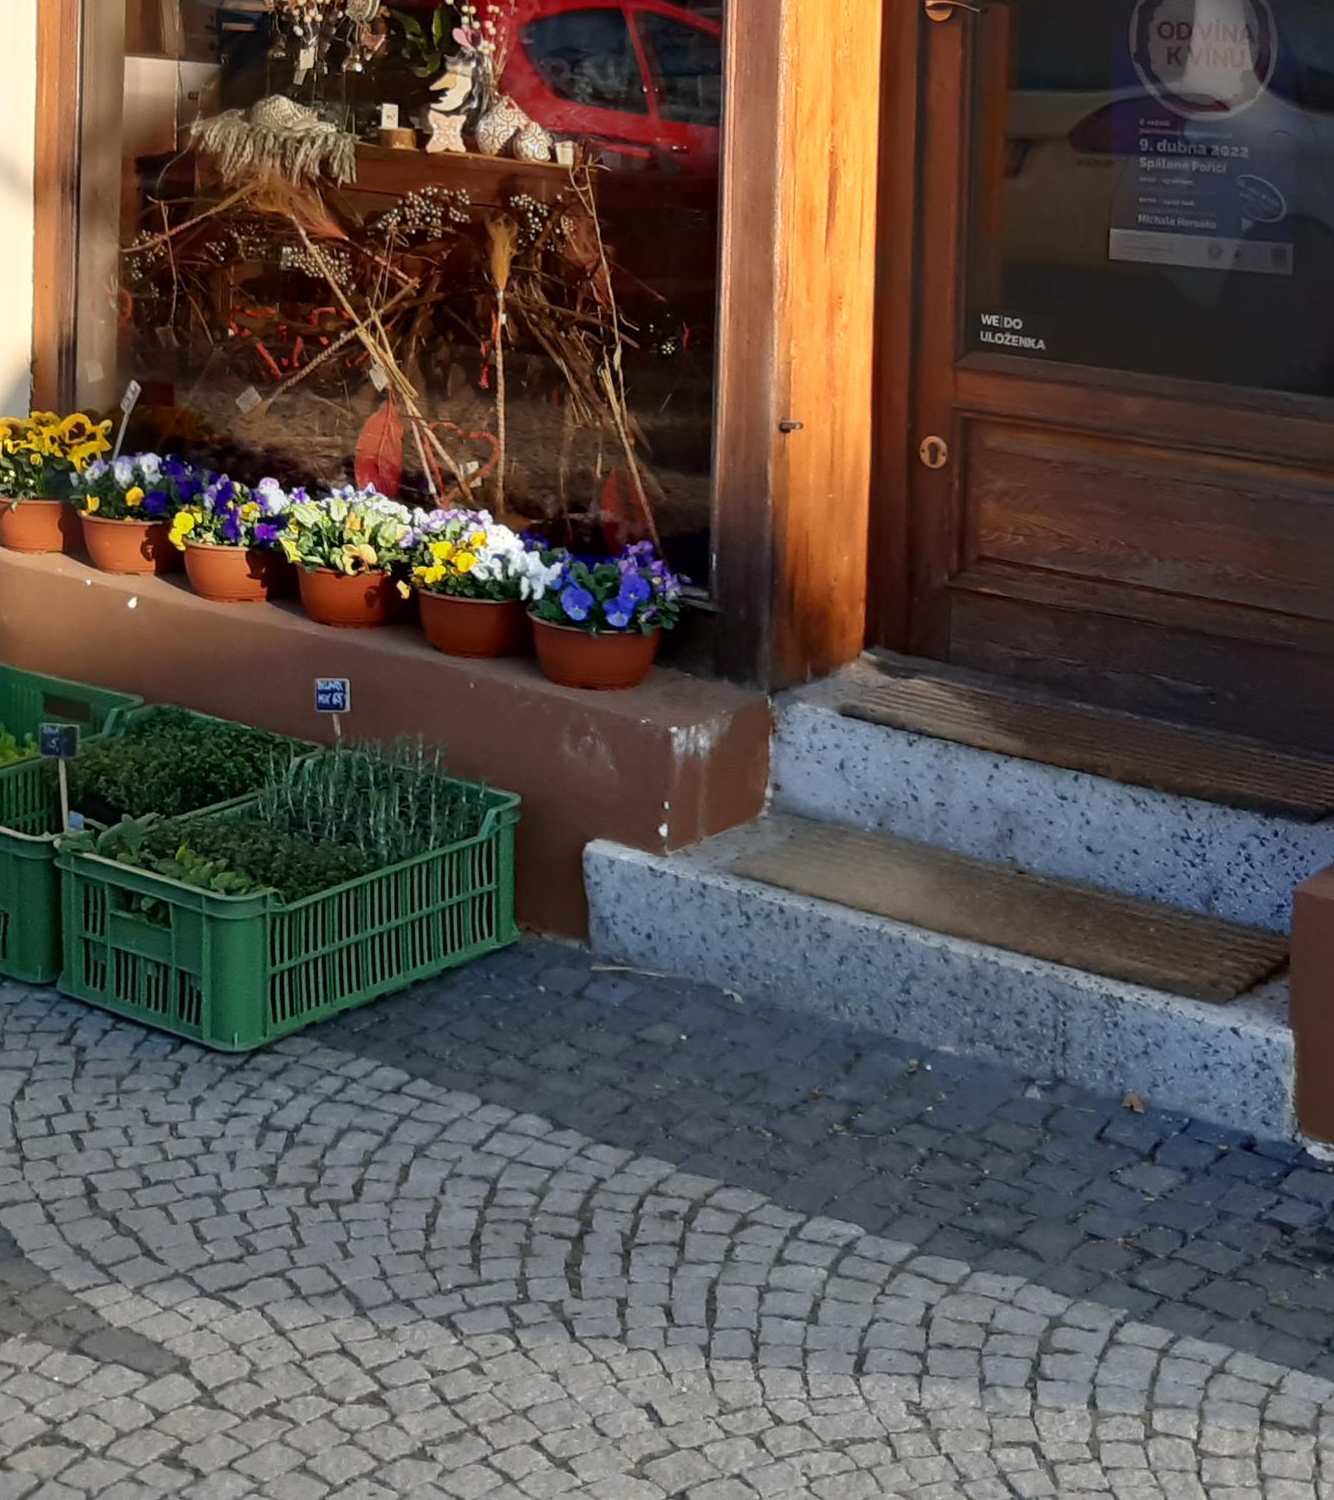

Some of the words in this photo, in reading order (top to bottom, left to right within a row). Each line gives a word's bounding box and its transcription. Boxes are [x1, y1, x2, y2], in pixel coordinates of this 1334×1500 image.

[1157, 22, 1192, 40] OD
[1167, 46, 1182, 65] K
[1157, 140, 1207, 155] dubna
[1211, 145, 1250, 159] 2022
[980, 330, 1046, 351] ULOŽENKA
